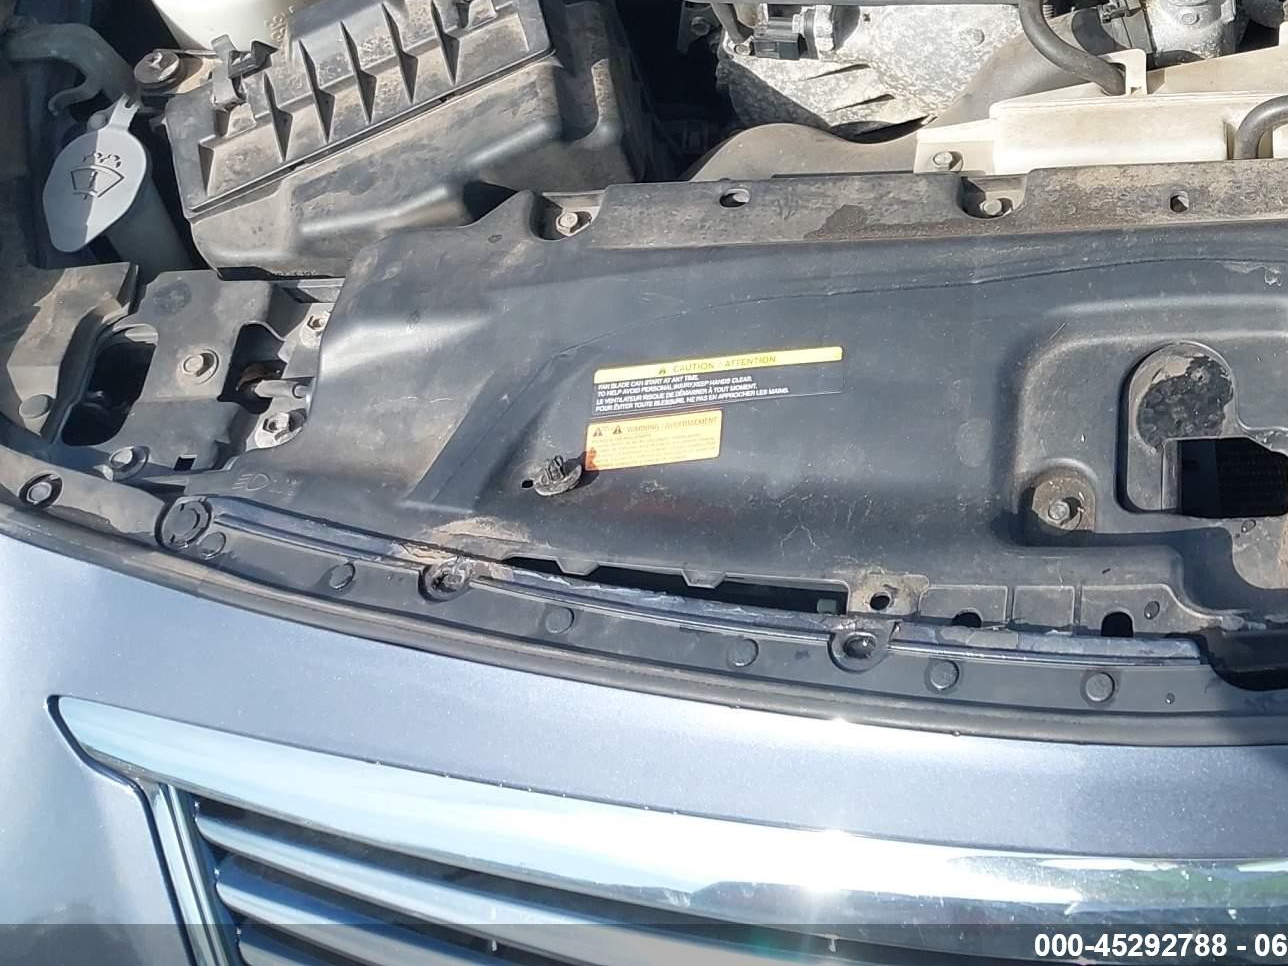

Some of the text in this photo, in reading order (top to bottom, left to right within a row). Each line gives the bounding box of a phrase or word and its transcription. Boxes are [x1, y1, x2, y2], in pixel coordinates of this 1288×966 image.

[673, 355, 777, 373] CAUTION ATTENTION
[626, 424, 660, 433] WARNING
